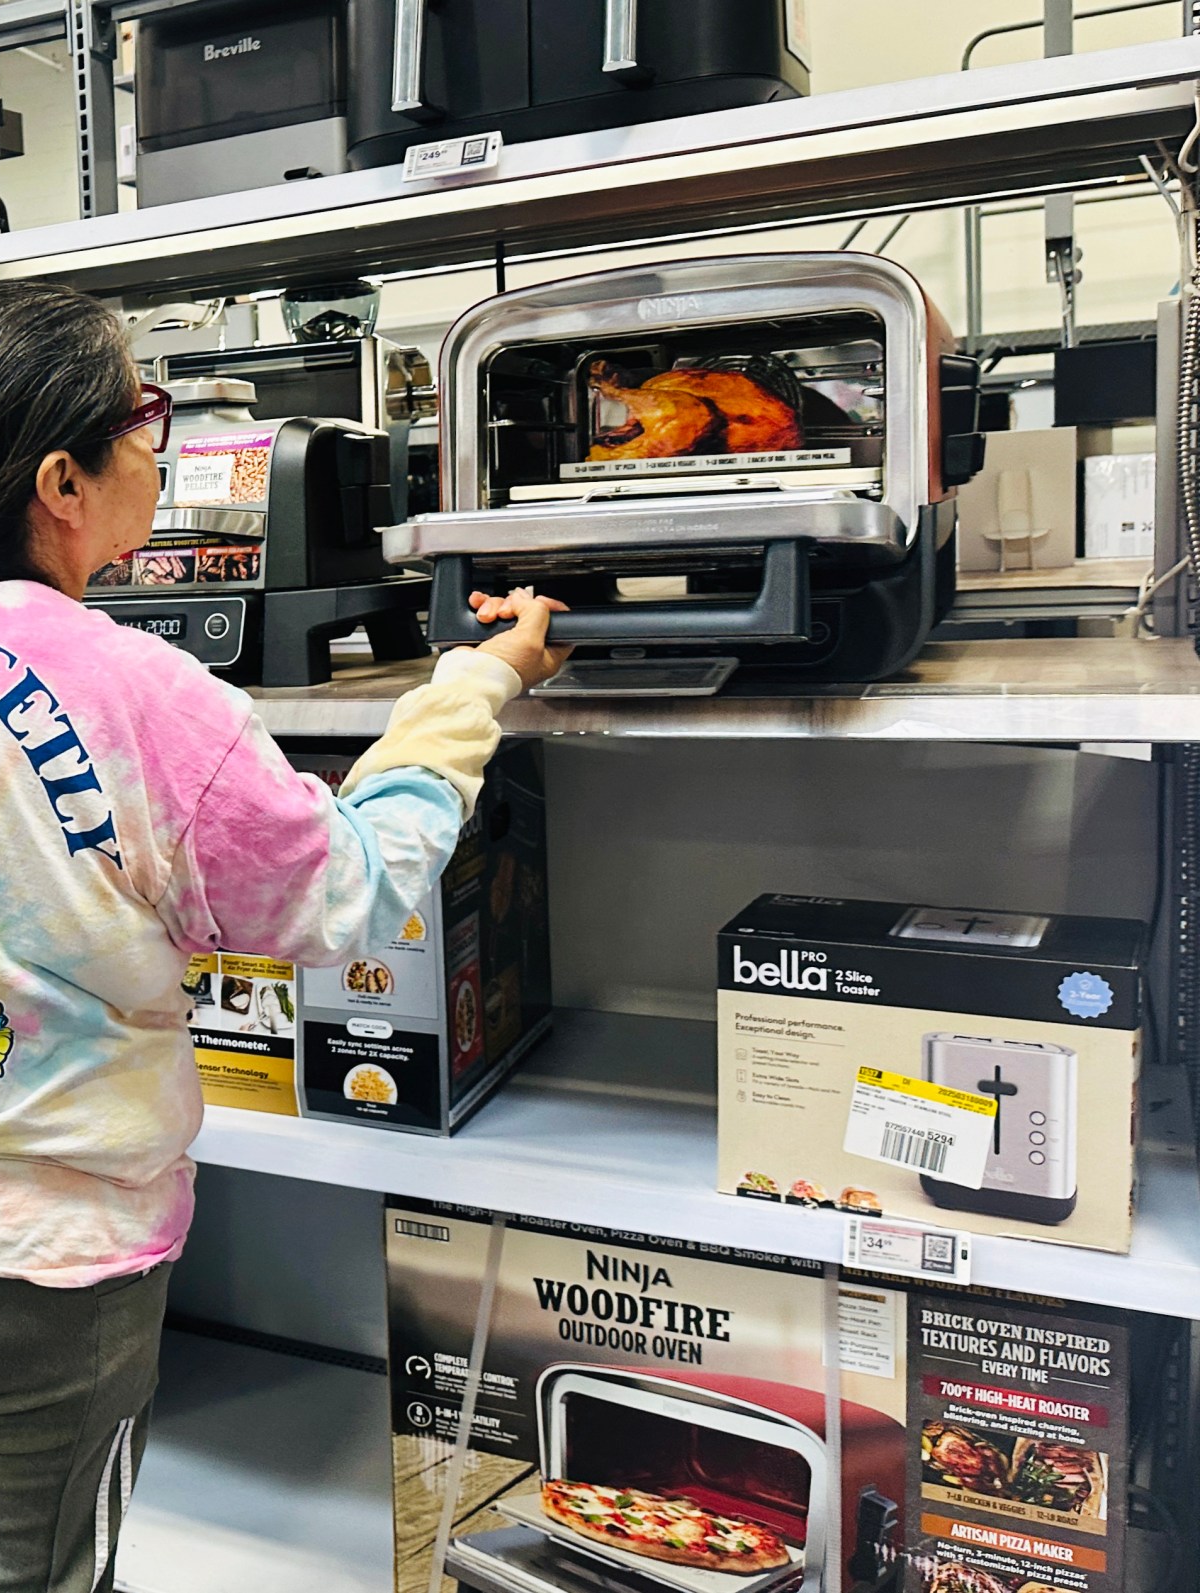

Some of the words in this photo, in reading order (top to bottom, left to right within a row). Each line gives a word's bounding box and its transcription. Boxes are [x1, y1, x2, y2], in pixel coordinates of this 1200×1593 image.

[203, 37, 261, 61] Breville
[183, 472, 224, 483] WOODFIRE
[184, 481, 219, 492] PELLETS
[733, 945, 827, 991] bella
[801, 951, 828, 963] PRO
[835, 970, 843, 981] 2
[845, 970, 873, 984] Slice
[835, 982, 881, 997] Toaster
[735, 1012, 786, 1025] Professional
[787, 1019, 846, 1032] performance.
[735, 1023, 785, 1035] Exceptional
[785, 1027, 816, 1040] design.
[200, 1034, 271, 1052] Thermometer.
[327, 1037, 347, 1047] Easily
[347, 1040, 363, 1050] sync
[364, 1041, 391, 1052] settings
[392, 1045, 414, 1054] across
[337, 1047, 356, 1055] zones
[357, 1048, 367, 1056] for
[368, 1050, 378, 1058] 2X
[379, 1052, 410, 1062] capacity.
[222, 1065, 269, 1080] Technology
[520, 1214, 568, 1231] Roaster
[570, 1222, 607, 1238] Oven,
[611, 1228, 645, 1243] Pizza
[649, 1233, 683, 1249] Oven
[686, 1240, 696, 1250] &
[700, 1242, 731, 1256] BBQ
[733, 1247, 787, 1265] Smoker
[790, 1256, 822, 1271] with
[586, 1249, 674, 1293] NINJA
[533, 1277, 730, 1342] WOODFIRE
[558, 1317, 648, 1355] OUTDOOR
[652, 1335, 703, 1365] OVEN
[921, 1309, 975, 1333] BRICK
[976, 1319, 1022, 1340] OVEN
[1025, 1326, 1111, 1354] INSPIRED
[433, 1352, 469, 1368] COMPLETE
[921, 1328, 998, 1357] TEXTURES
[1001, 1342, 1036, 1364] AND
[1039, 1348, 1111, 1377] FLAVORS
[982, 1359, 1018, 1379] EVERY
[1021, 1366, 1049, 1384] TIME
[940, 1381, 974, 1399] 700°F
[975, 1389, 1037, 1412] HIGH-HEAT
[1039, 1399, 1090, 1422] ROASTER
[943, 1412, 989, 1428] blistering,
[990, 1421, 1008, 1431] and
[1009, 1424, 1045, 1439] sizzling
[1046, 1430, 1057, 1439] at
[1057, 1433, 1086, 1445] home
[949, 1404, 998, 1420] Brick-oven
[999, 1413, 1037, 1428] inspired
[1038, 1420, 1080, 1437] charring,
[946, 1491, 963, 1502] 7-LB
[963, 1494, 991, 1509] CHICKEN
[991, 1500, 997, 1510] &
[999, 1502, 1026, 1516] VEGGIES
[951, 1523, 998, 1545] ARTISAN
[999, 1533, 1032, 1554] PIZZA
[1033, 1542, 1074, 1563] MAKER
[936, 1549, 956, 1560] with
[965, 1556, 1025, 1576] customizable
[1026, 1569, 1052, 1582] pizza
[1053, 1576, 1089, 1590] presets
[937, 1541, 975, 1557] No-turn,
[976, 1550, 1020, 1568] 3-minute,
[1021, 1559, 1054, 1574] 12-inch
